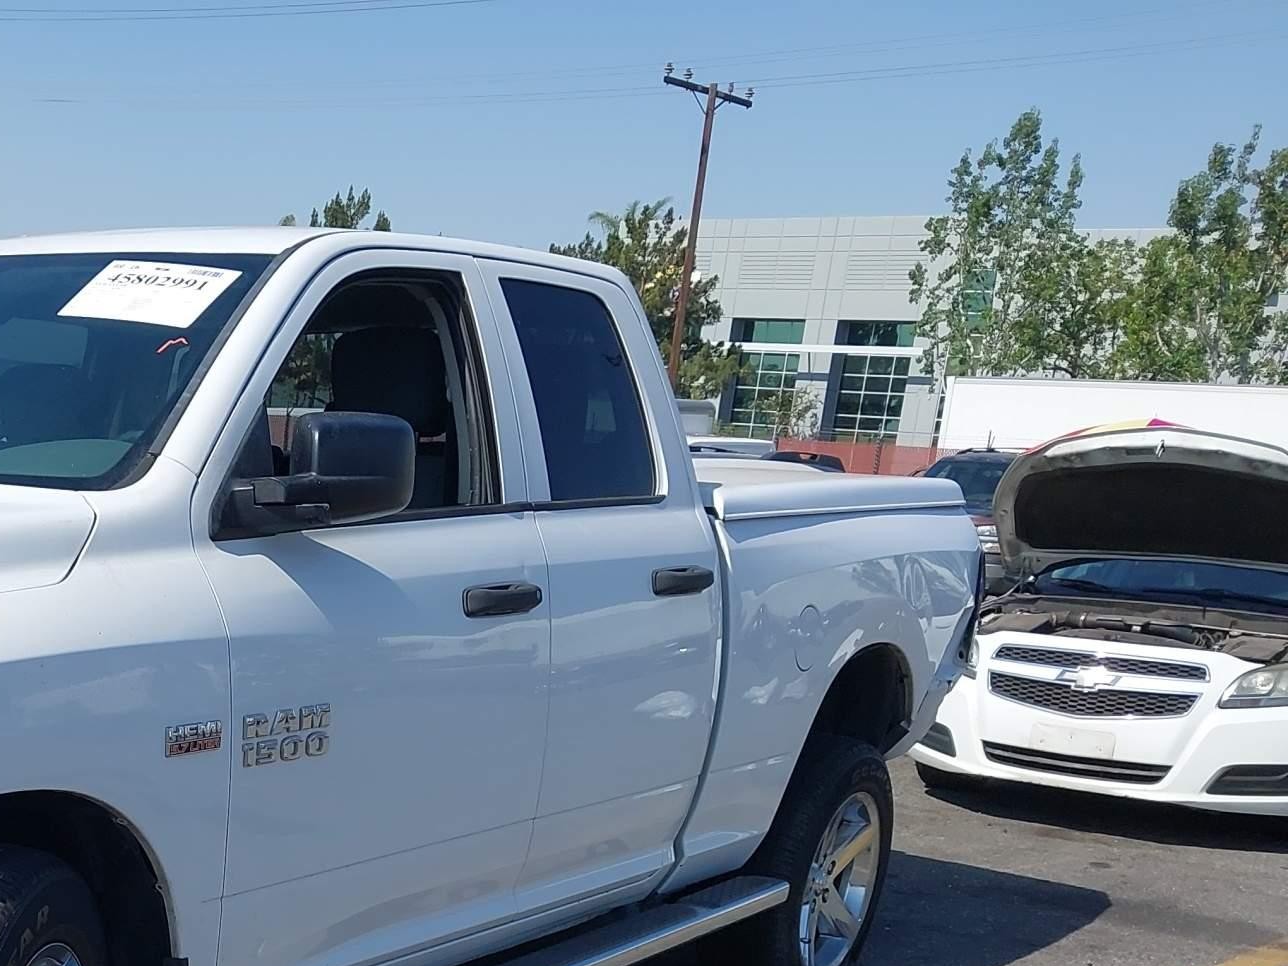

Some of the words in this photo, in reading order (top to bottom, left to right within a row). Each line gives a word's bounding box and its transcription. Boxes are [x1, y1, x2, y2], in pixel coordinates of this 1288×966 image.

[107, 272, 209, 291] 45802991
[165, 719, 222, 743] HEMI
[242, 702, 331, 740] RAM
[241, 730, 330, 768] 1500
